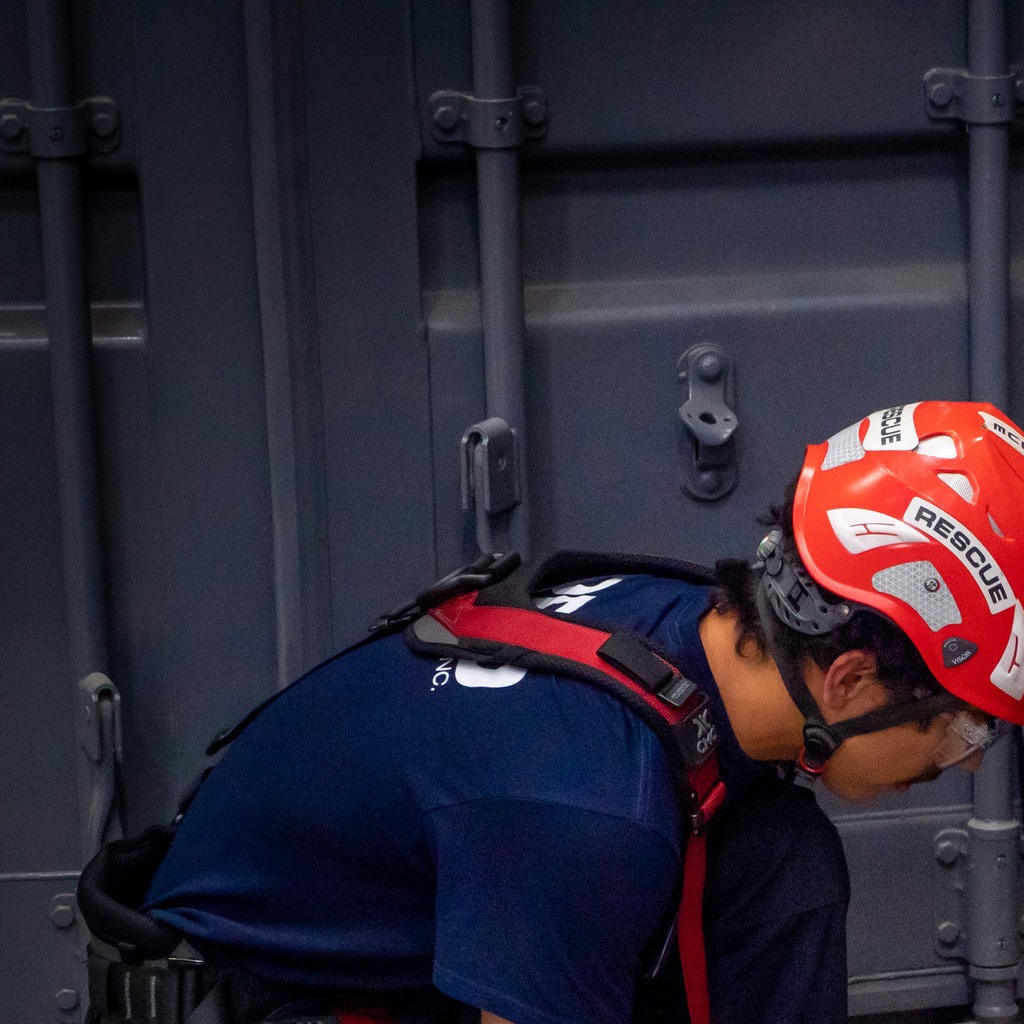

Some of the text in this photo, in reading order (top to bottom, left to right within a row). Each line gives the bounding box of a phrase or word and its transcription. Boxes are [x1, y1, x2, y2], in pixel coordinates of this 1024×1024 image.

[914, 505, 1008, 605] RESCUE
[430, 657, 453, 692] NC.
[951, 650, 972, 665] VISOR
